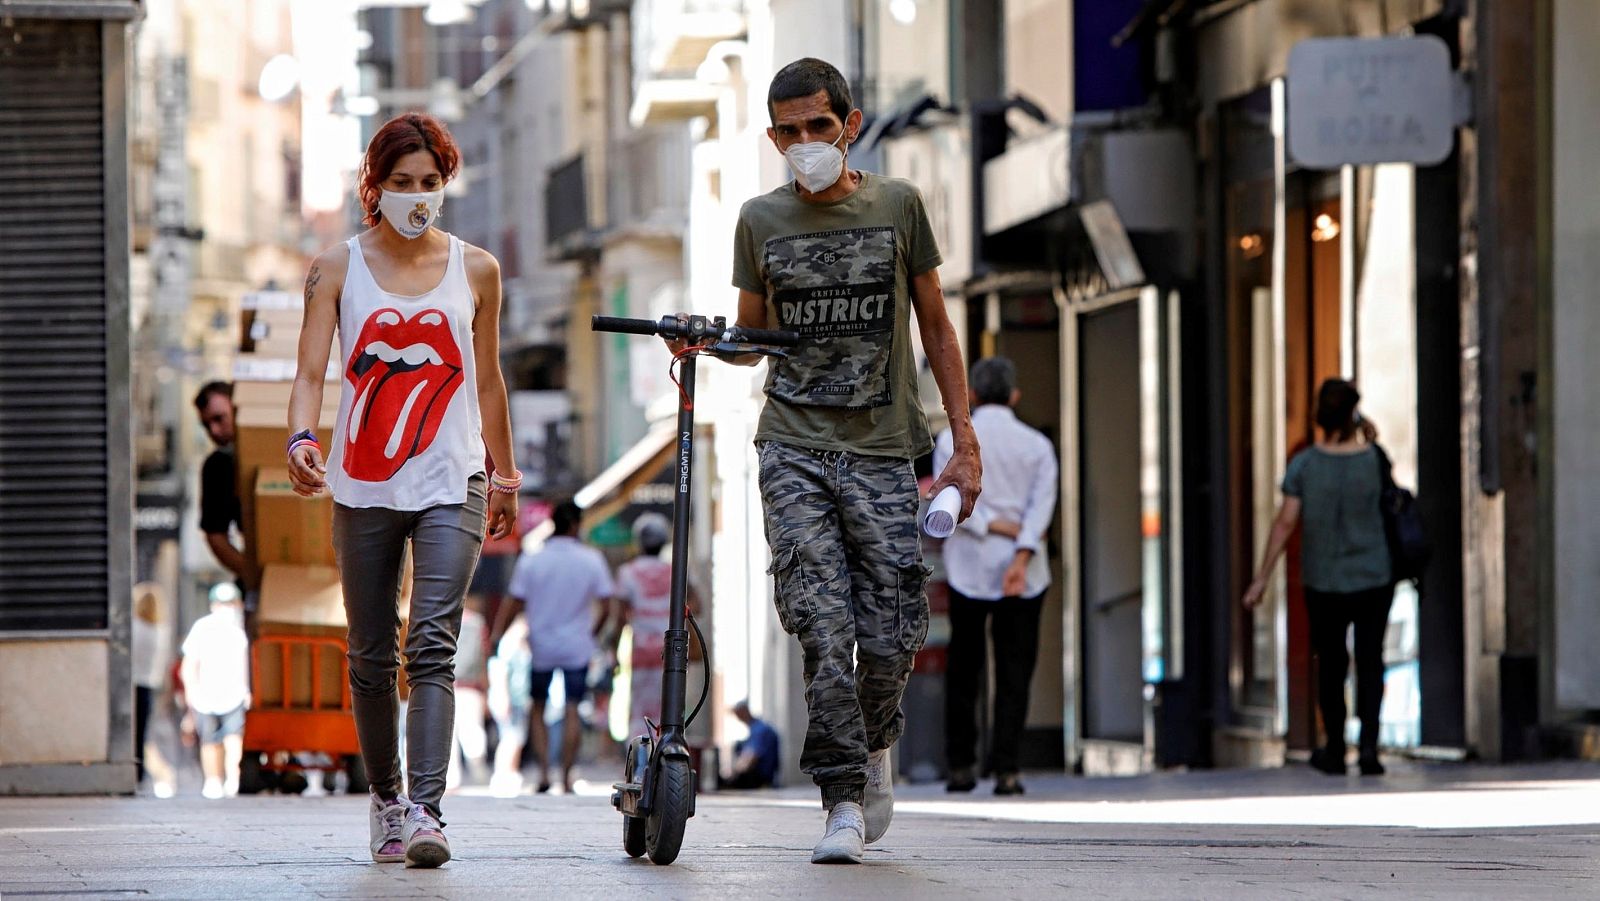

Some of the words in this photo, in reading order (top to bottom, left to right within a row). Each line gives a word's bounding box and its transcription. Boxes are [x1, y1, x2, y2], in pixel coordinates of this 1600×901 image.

[823, 252, 836, 263] 85
[811, 288, 852, 298] CENTRAL
[782, 294, 889, 325] DISTRICT
[680, 431, 690, 493] BRIGMTON
